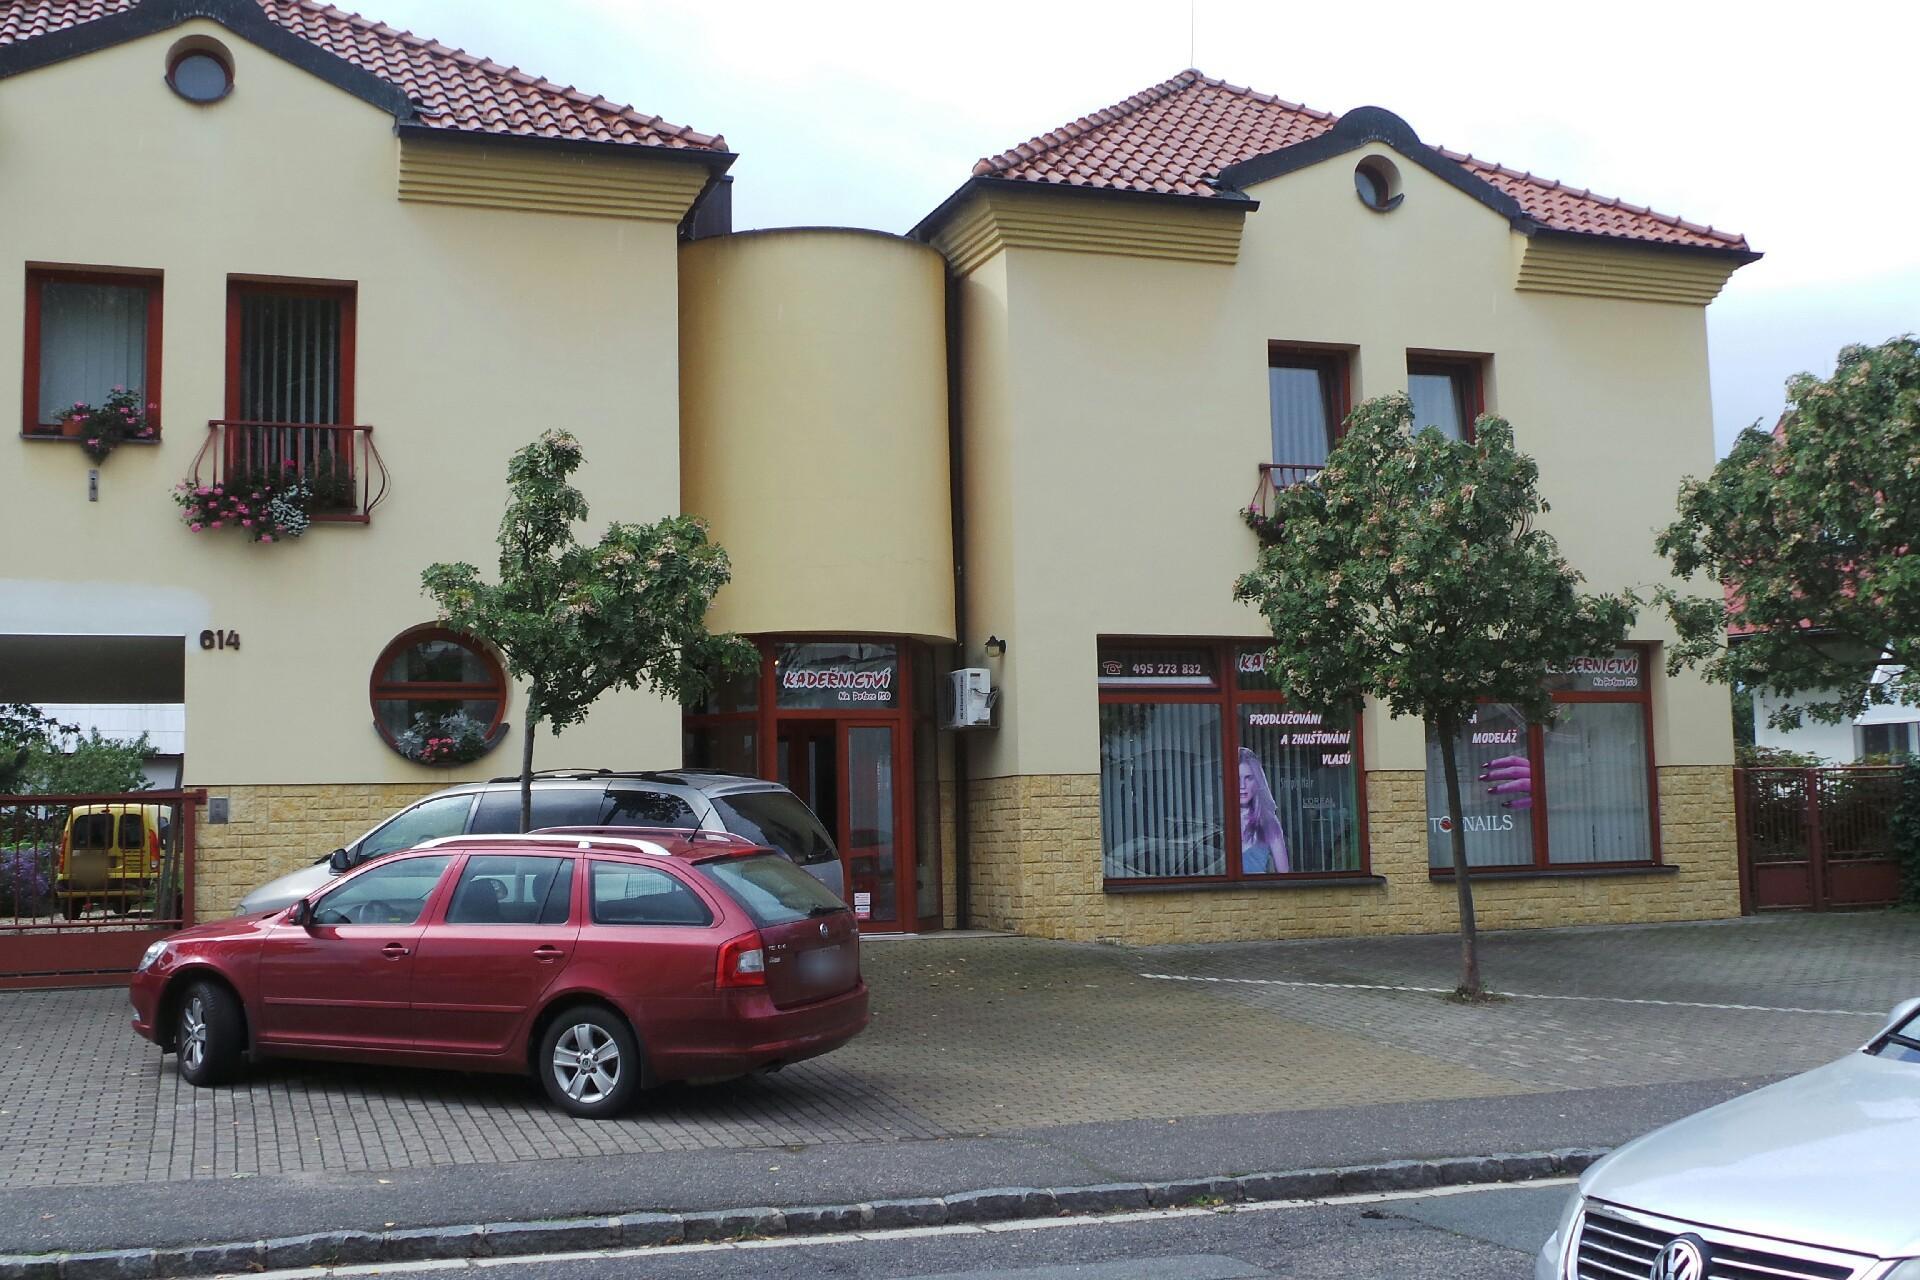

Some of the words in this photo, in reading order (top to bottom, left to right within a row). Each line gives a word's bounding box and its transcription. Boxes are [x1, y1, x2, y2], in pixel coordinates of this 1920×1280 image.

[200, 629, 240, 650] 614
[1133, 663, 1154, 674] 495
[1158, 663, 1177, 674] 273
[1182, 663, 1201, 674] 832
[783, 667, 891, 688] KADEŘNICTVÍ
[838, 692, 850, 700] Na
[1280, 734, 1288, 744] A
[1472, 730, 1517, 743] MODELÁŽ
